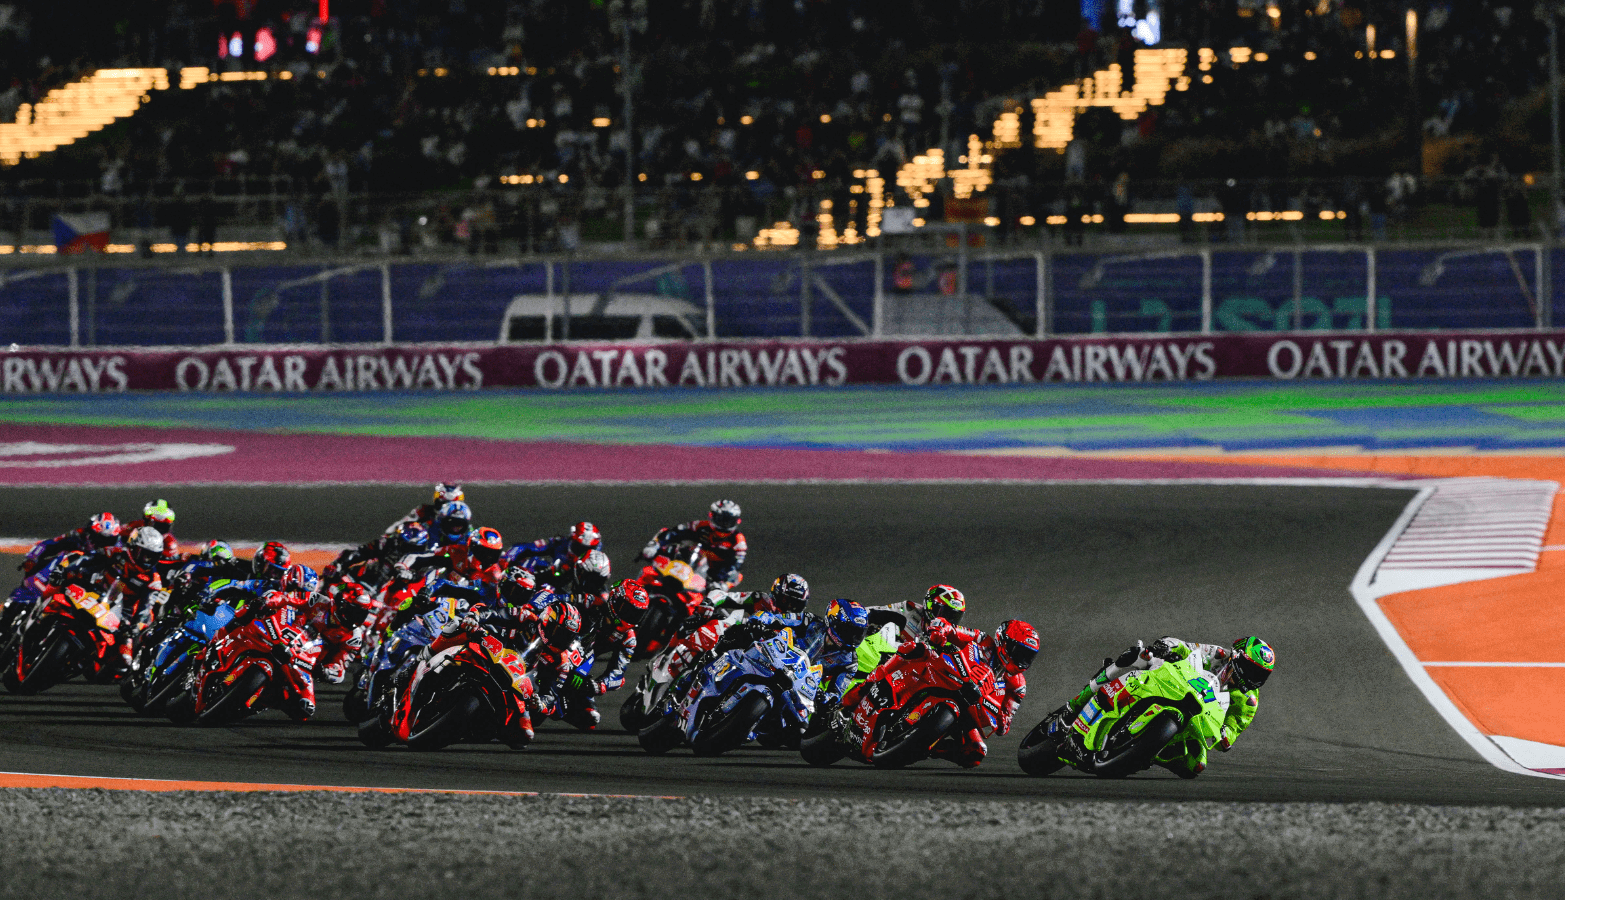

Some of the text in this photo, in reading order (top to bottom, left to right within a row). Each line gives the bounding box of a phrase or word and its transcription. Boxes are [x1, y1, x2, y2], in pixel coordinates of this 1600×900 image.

[2, 357, 128, 393] RWAYS
[175, 352, 484, 393] QATAR AIRWAYS
[534, 347, 848, 388] QATAR AIRWAYS
[897, 343, 1216, 384] QATAR AIRWAYS
[1267, 340, 1407, 378] QATAR
[953, 653, 967, 677] Lenovo
[983, 698, 999, 714] Lenovo
[1188, 677, 1217, 704] 21
